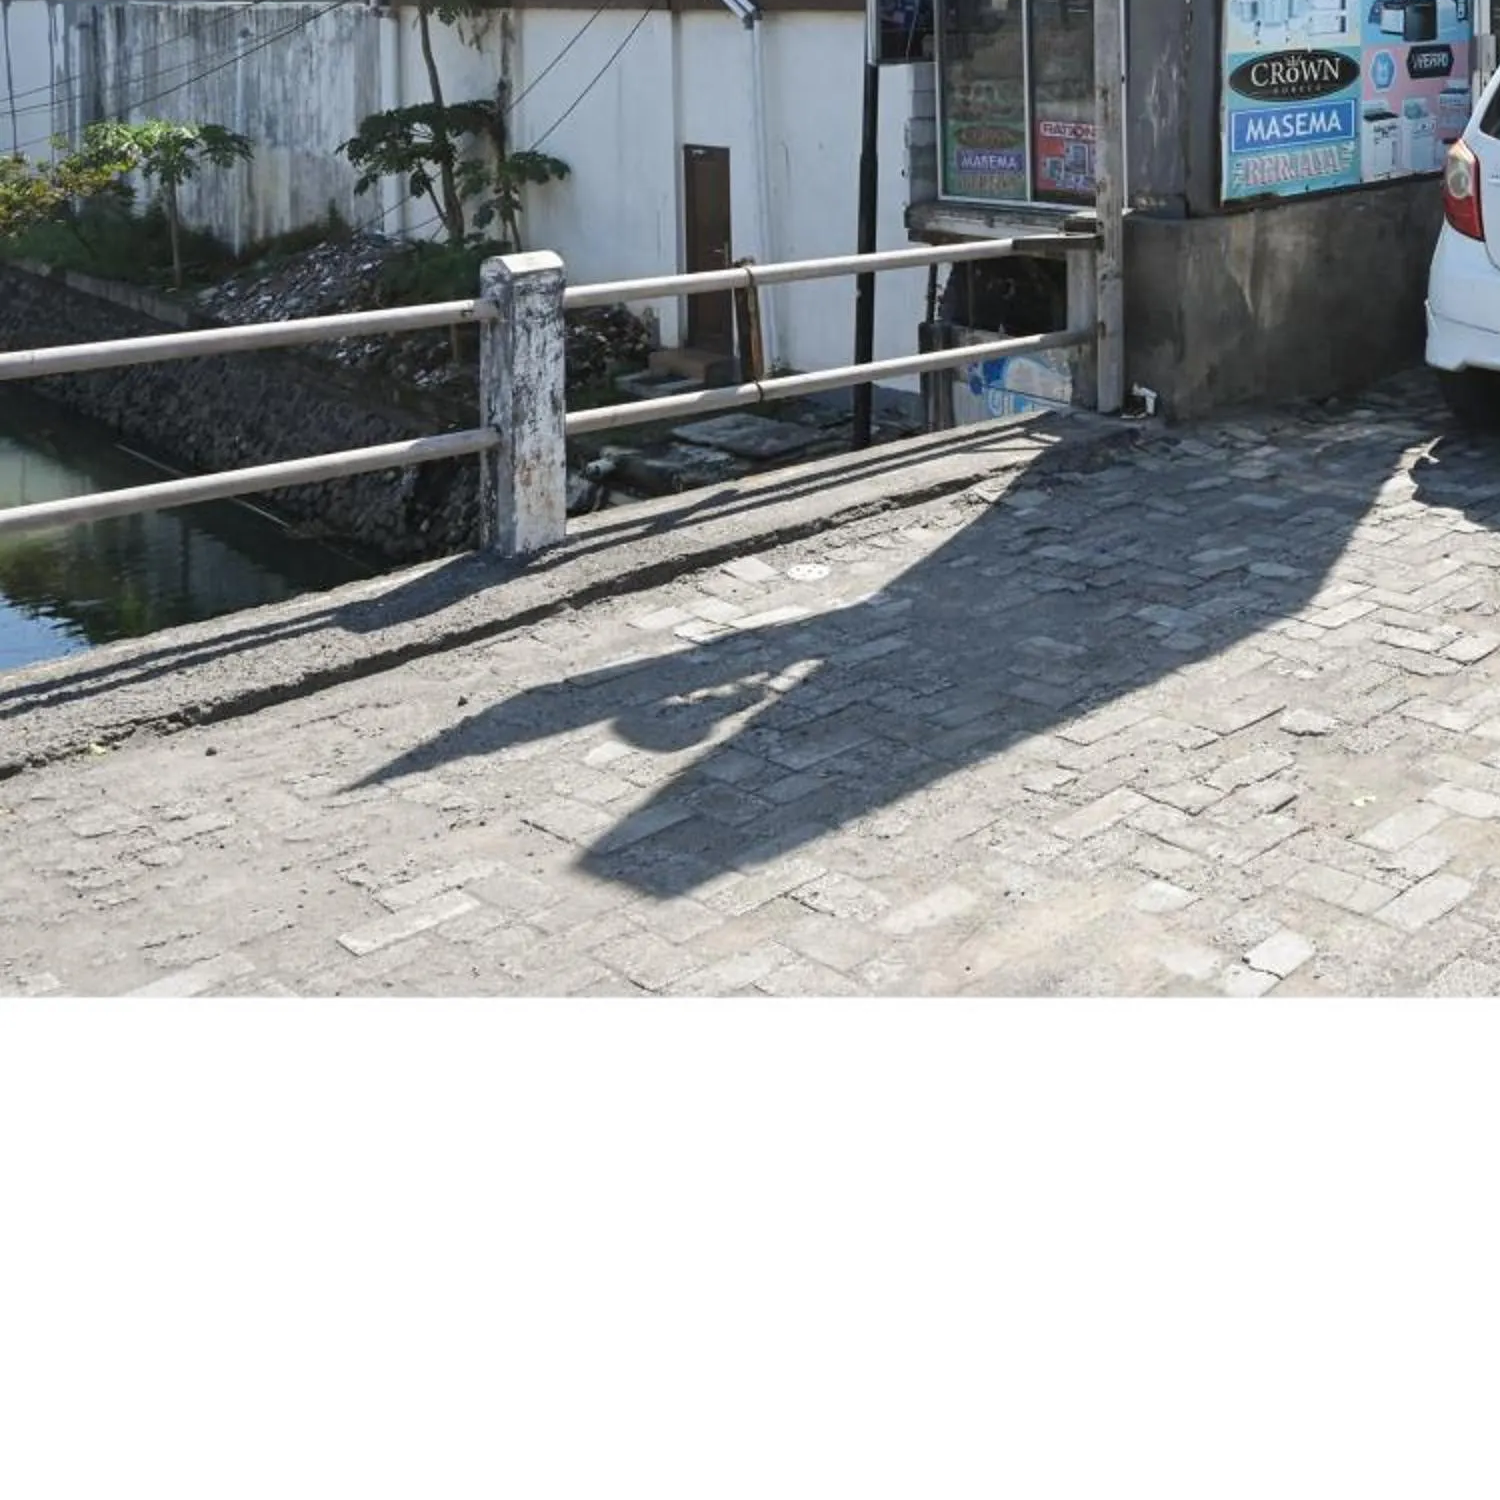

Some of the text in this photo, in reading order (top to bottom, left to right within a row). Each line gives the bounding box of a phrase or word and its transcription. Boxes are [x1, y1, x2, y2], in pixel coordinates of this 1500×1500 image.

[1251, 57, 1341, 87] CROWN
[1042, 123, 1096, 138] RATION
[1246, 109, 1342, 143] MASEMA
